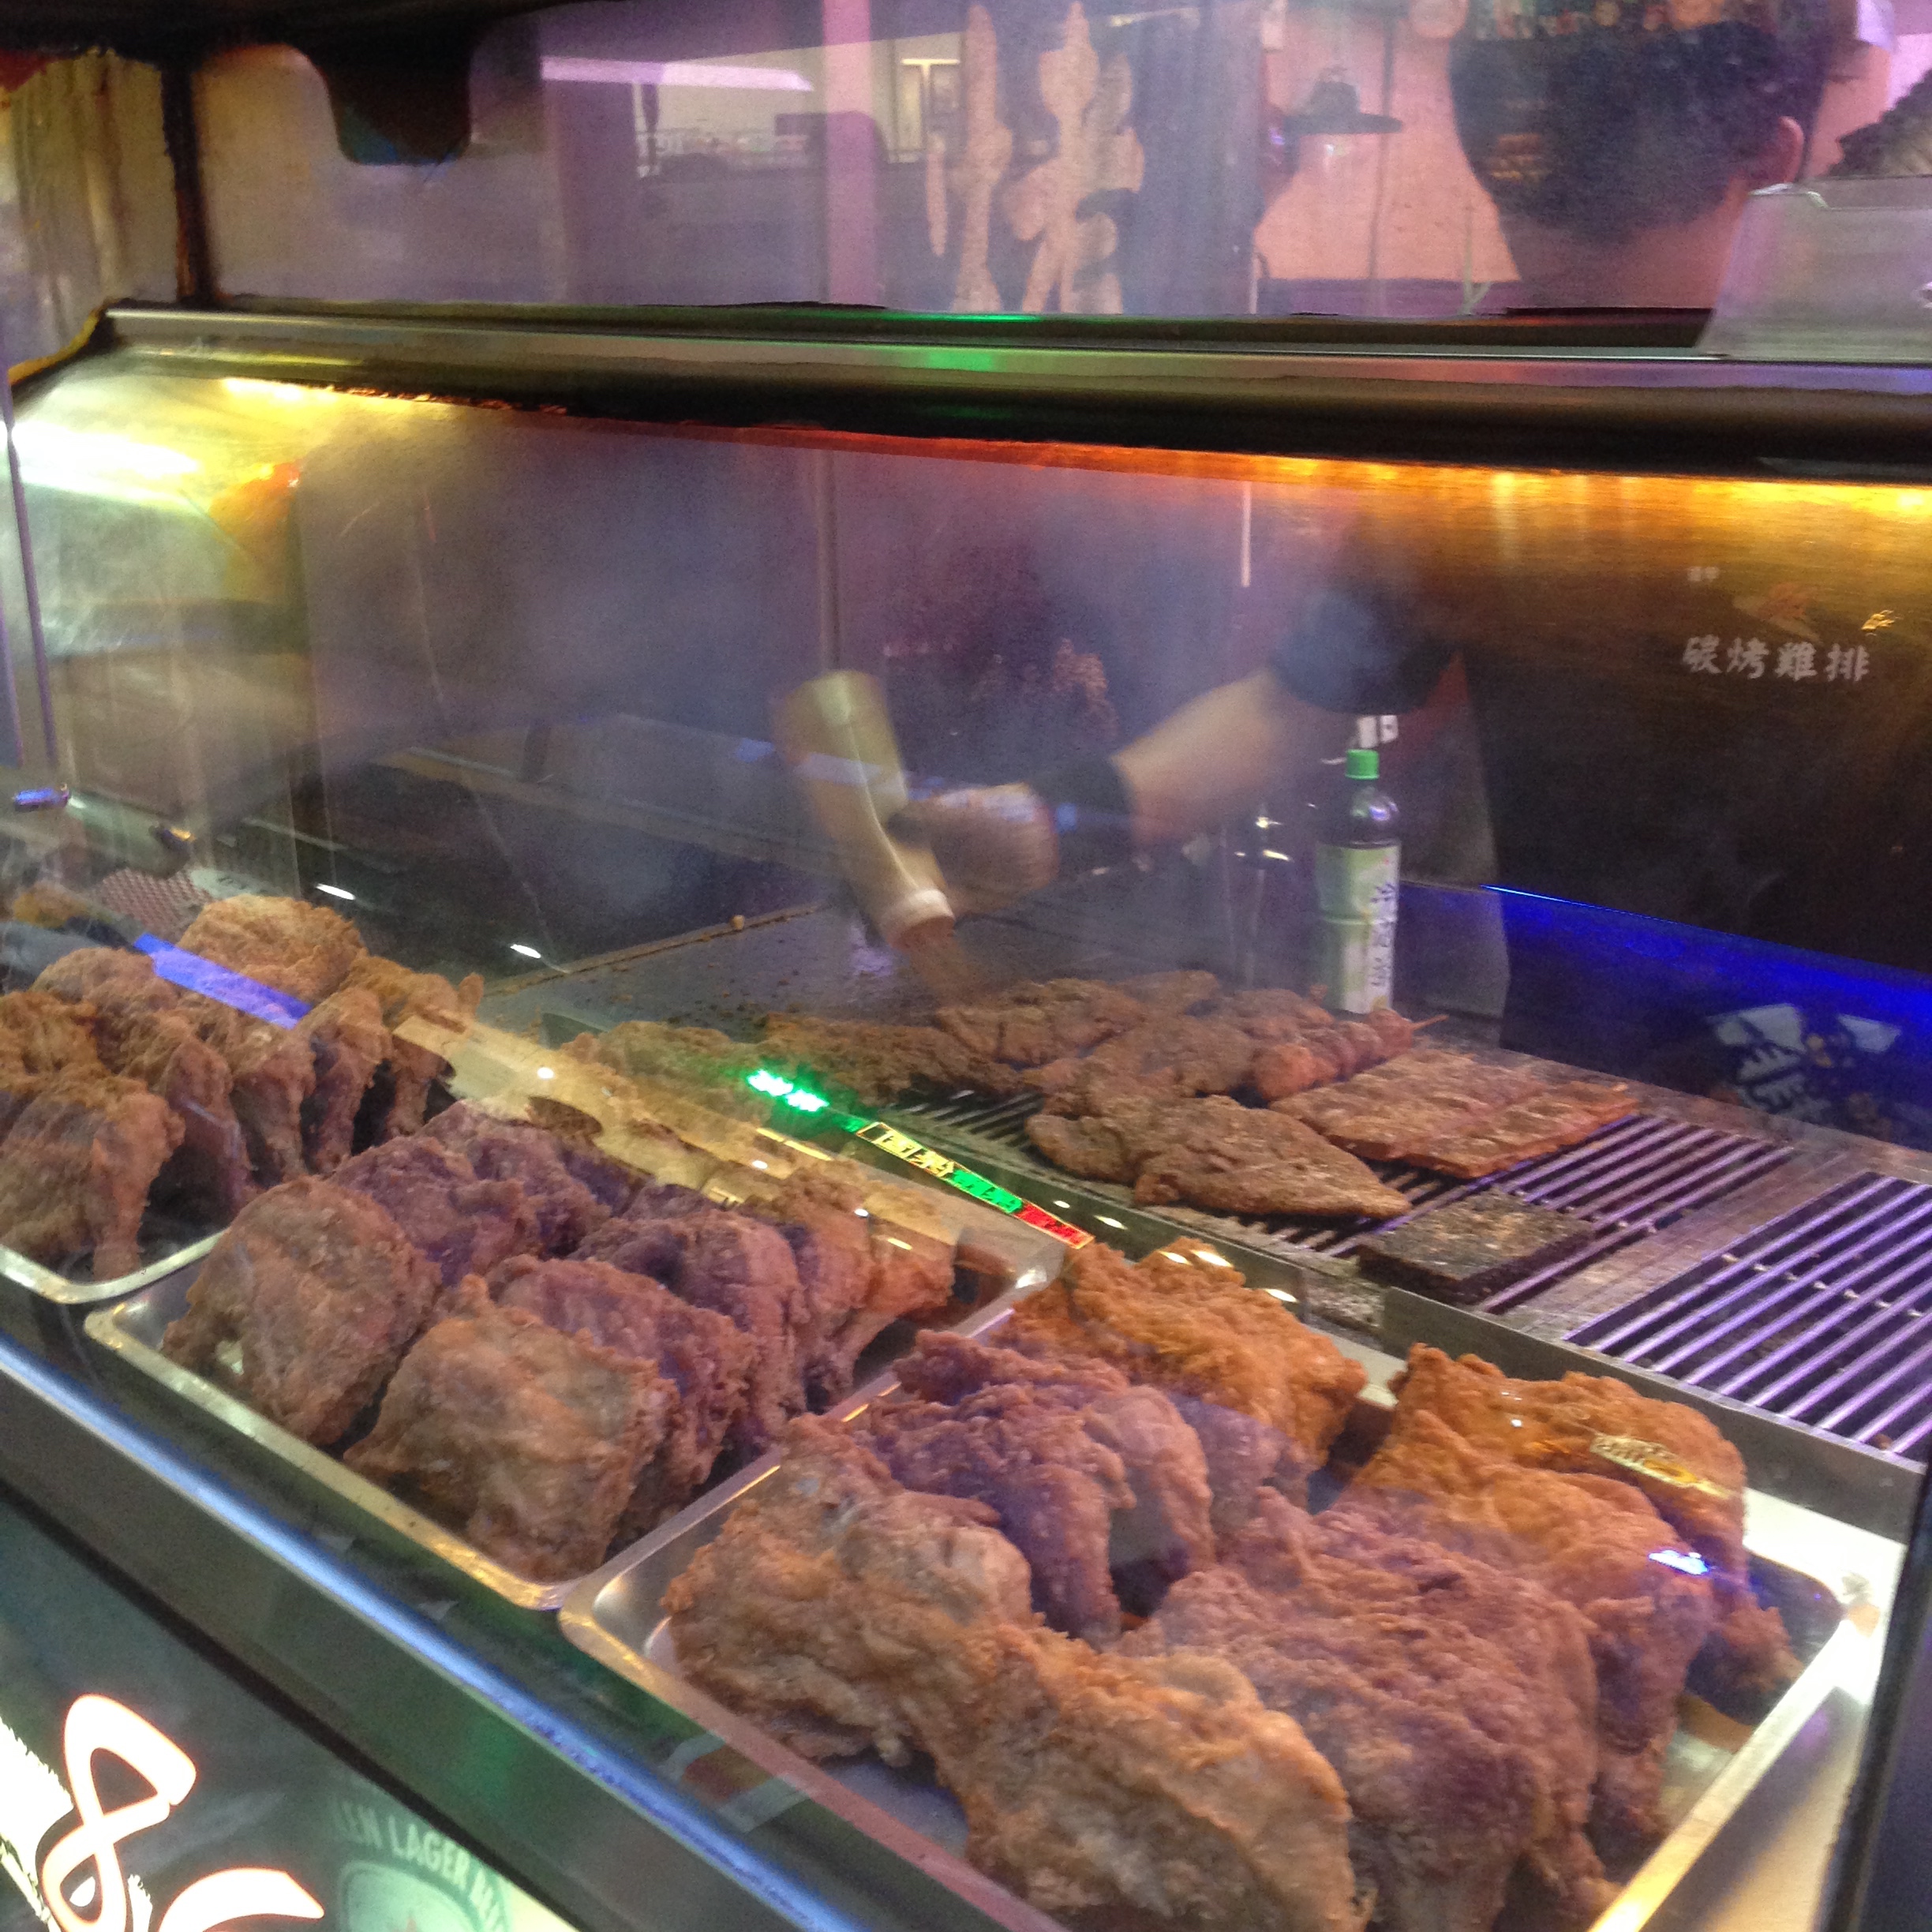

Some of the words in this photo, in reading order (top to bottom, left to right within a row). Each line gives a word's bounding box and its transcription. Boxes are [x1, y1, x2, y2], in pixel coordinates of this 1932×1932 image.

[1683, 635, 1870, 682] 碳烤雞排
[388, 1814, 471, 1891] LAGER
